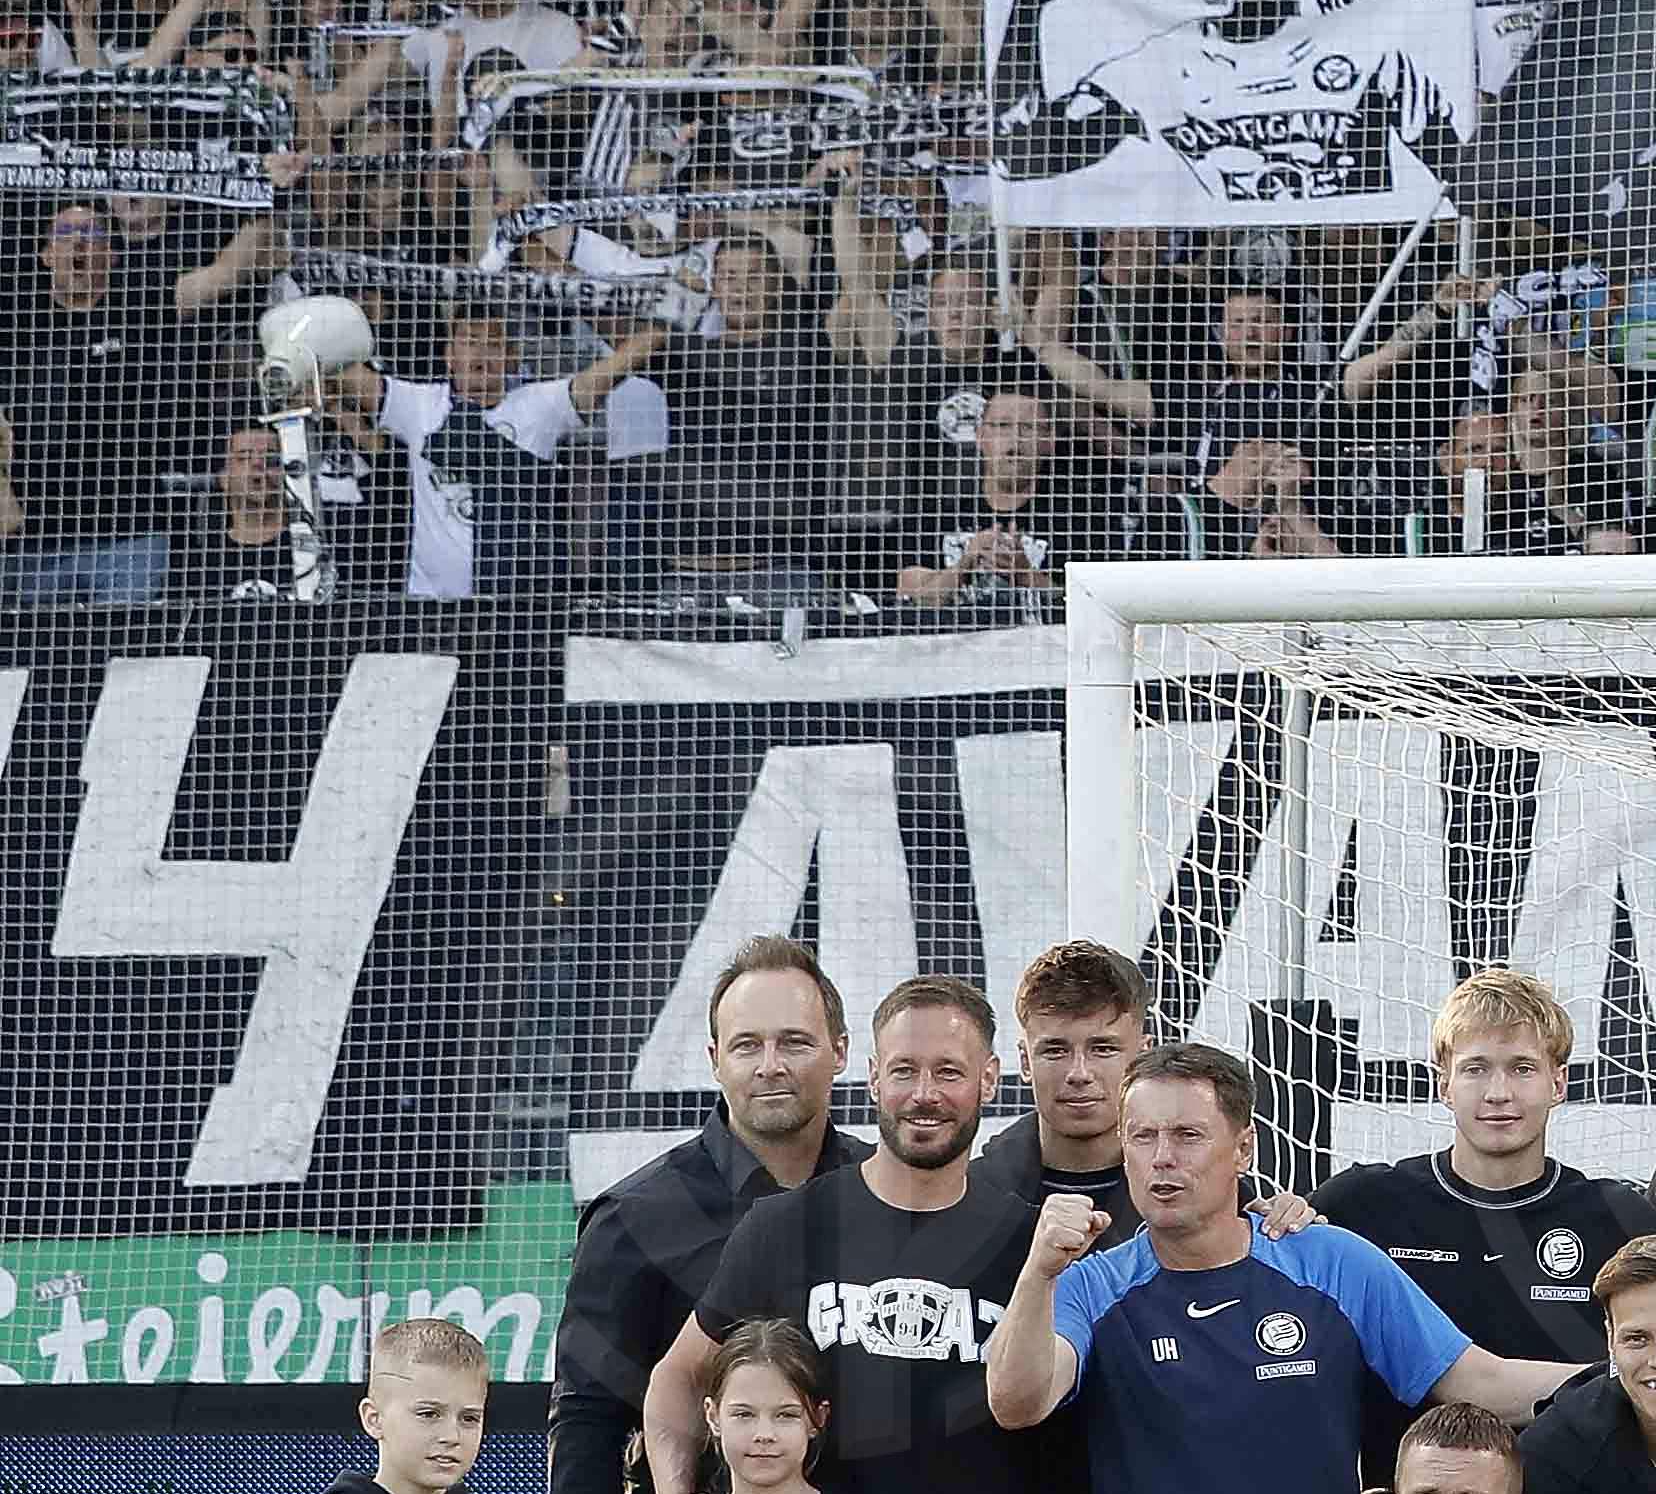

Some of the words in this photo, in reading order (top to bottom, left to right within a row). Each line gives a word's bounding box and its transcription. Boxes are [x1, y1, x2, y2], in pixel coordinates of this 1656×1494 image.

[0, 653, 458, 1186] 4
[1533, 1287, 1588, 1300] PUNTIGAMER
[1151, 1336, 1180, 1362] UH
[1259, 1363, 1315, 1379] PUNTIGAMER
